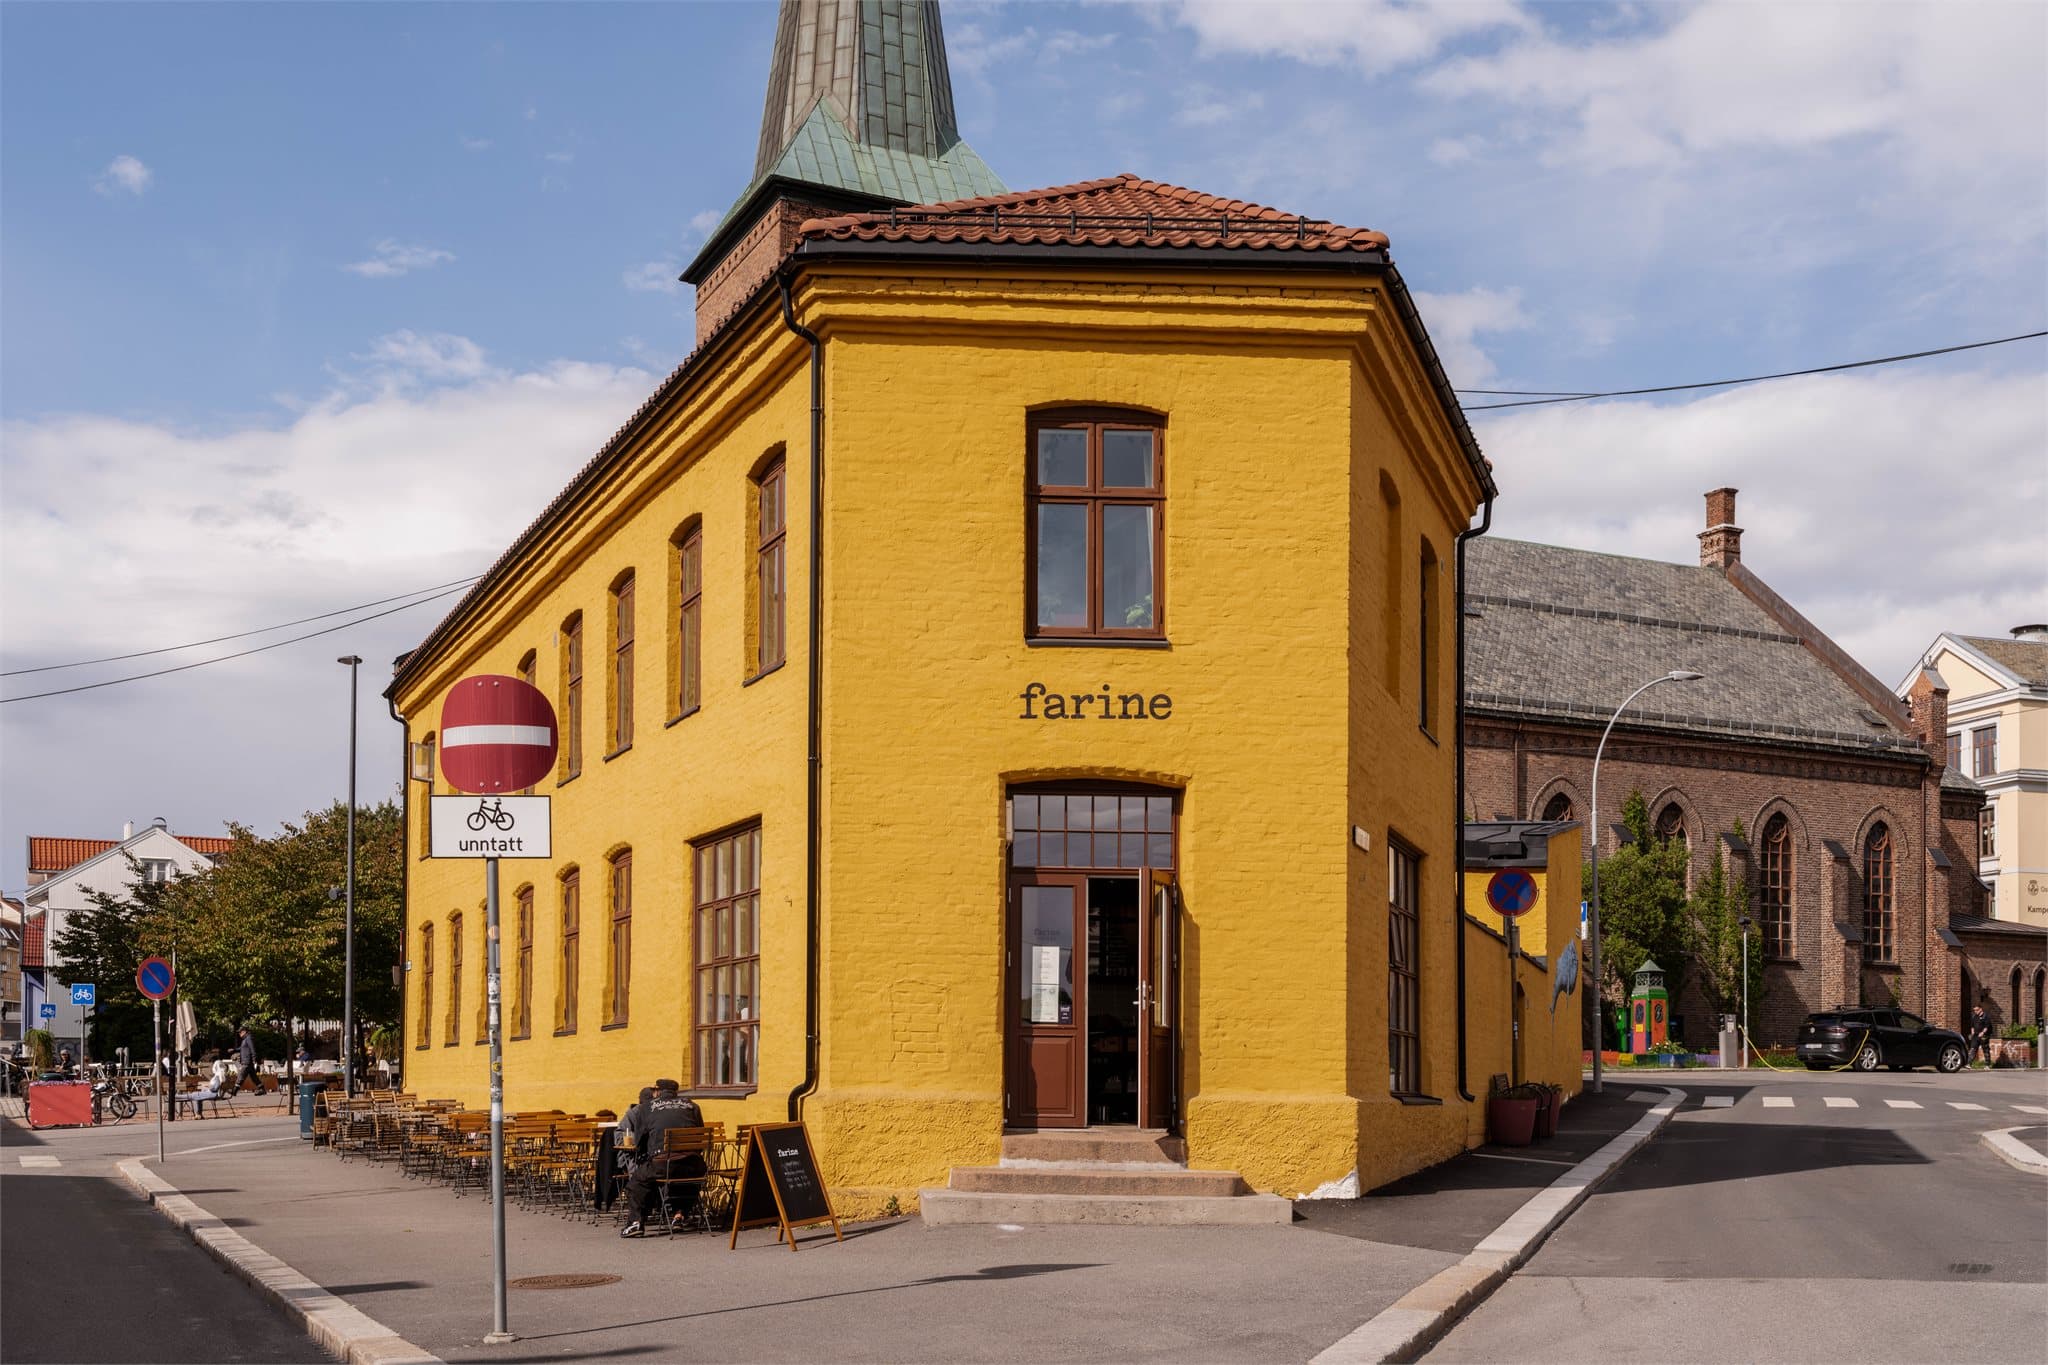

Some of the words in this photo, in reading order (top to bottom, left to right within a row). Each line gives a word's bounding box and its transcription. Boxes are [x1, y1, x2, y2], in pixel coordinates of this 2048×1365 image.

[1019, 682, 1173, 720] farine
[459, 837, 523, 851] unntatt
[2027, 905, 2048, 915] Kamp
